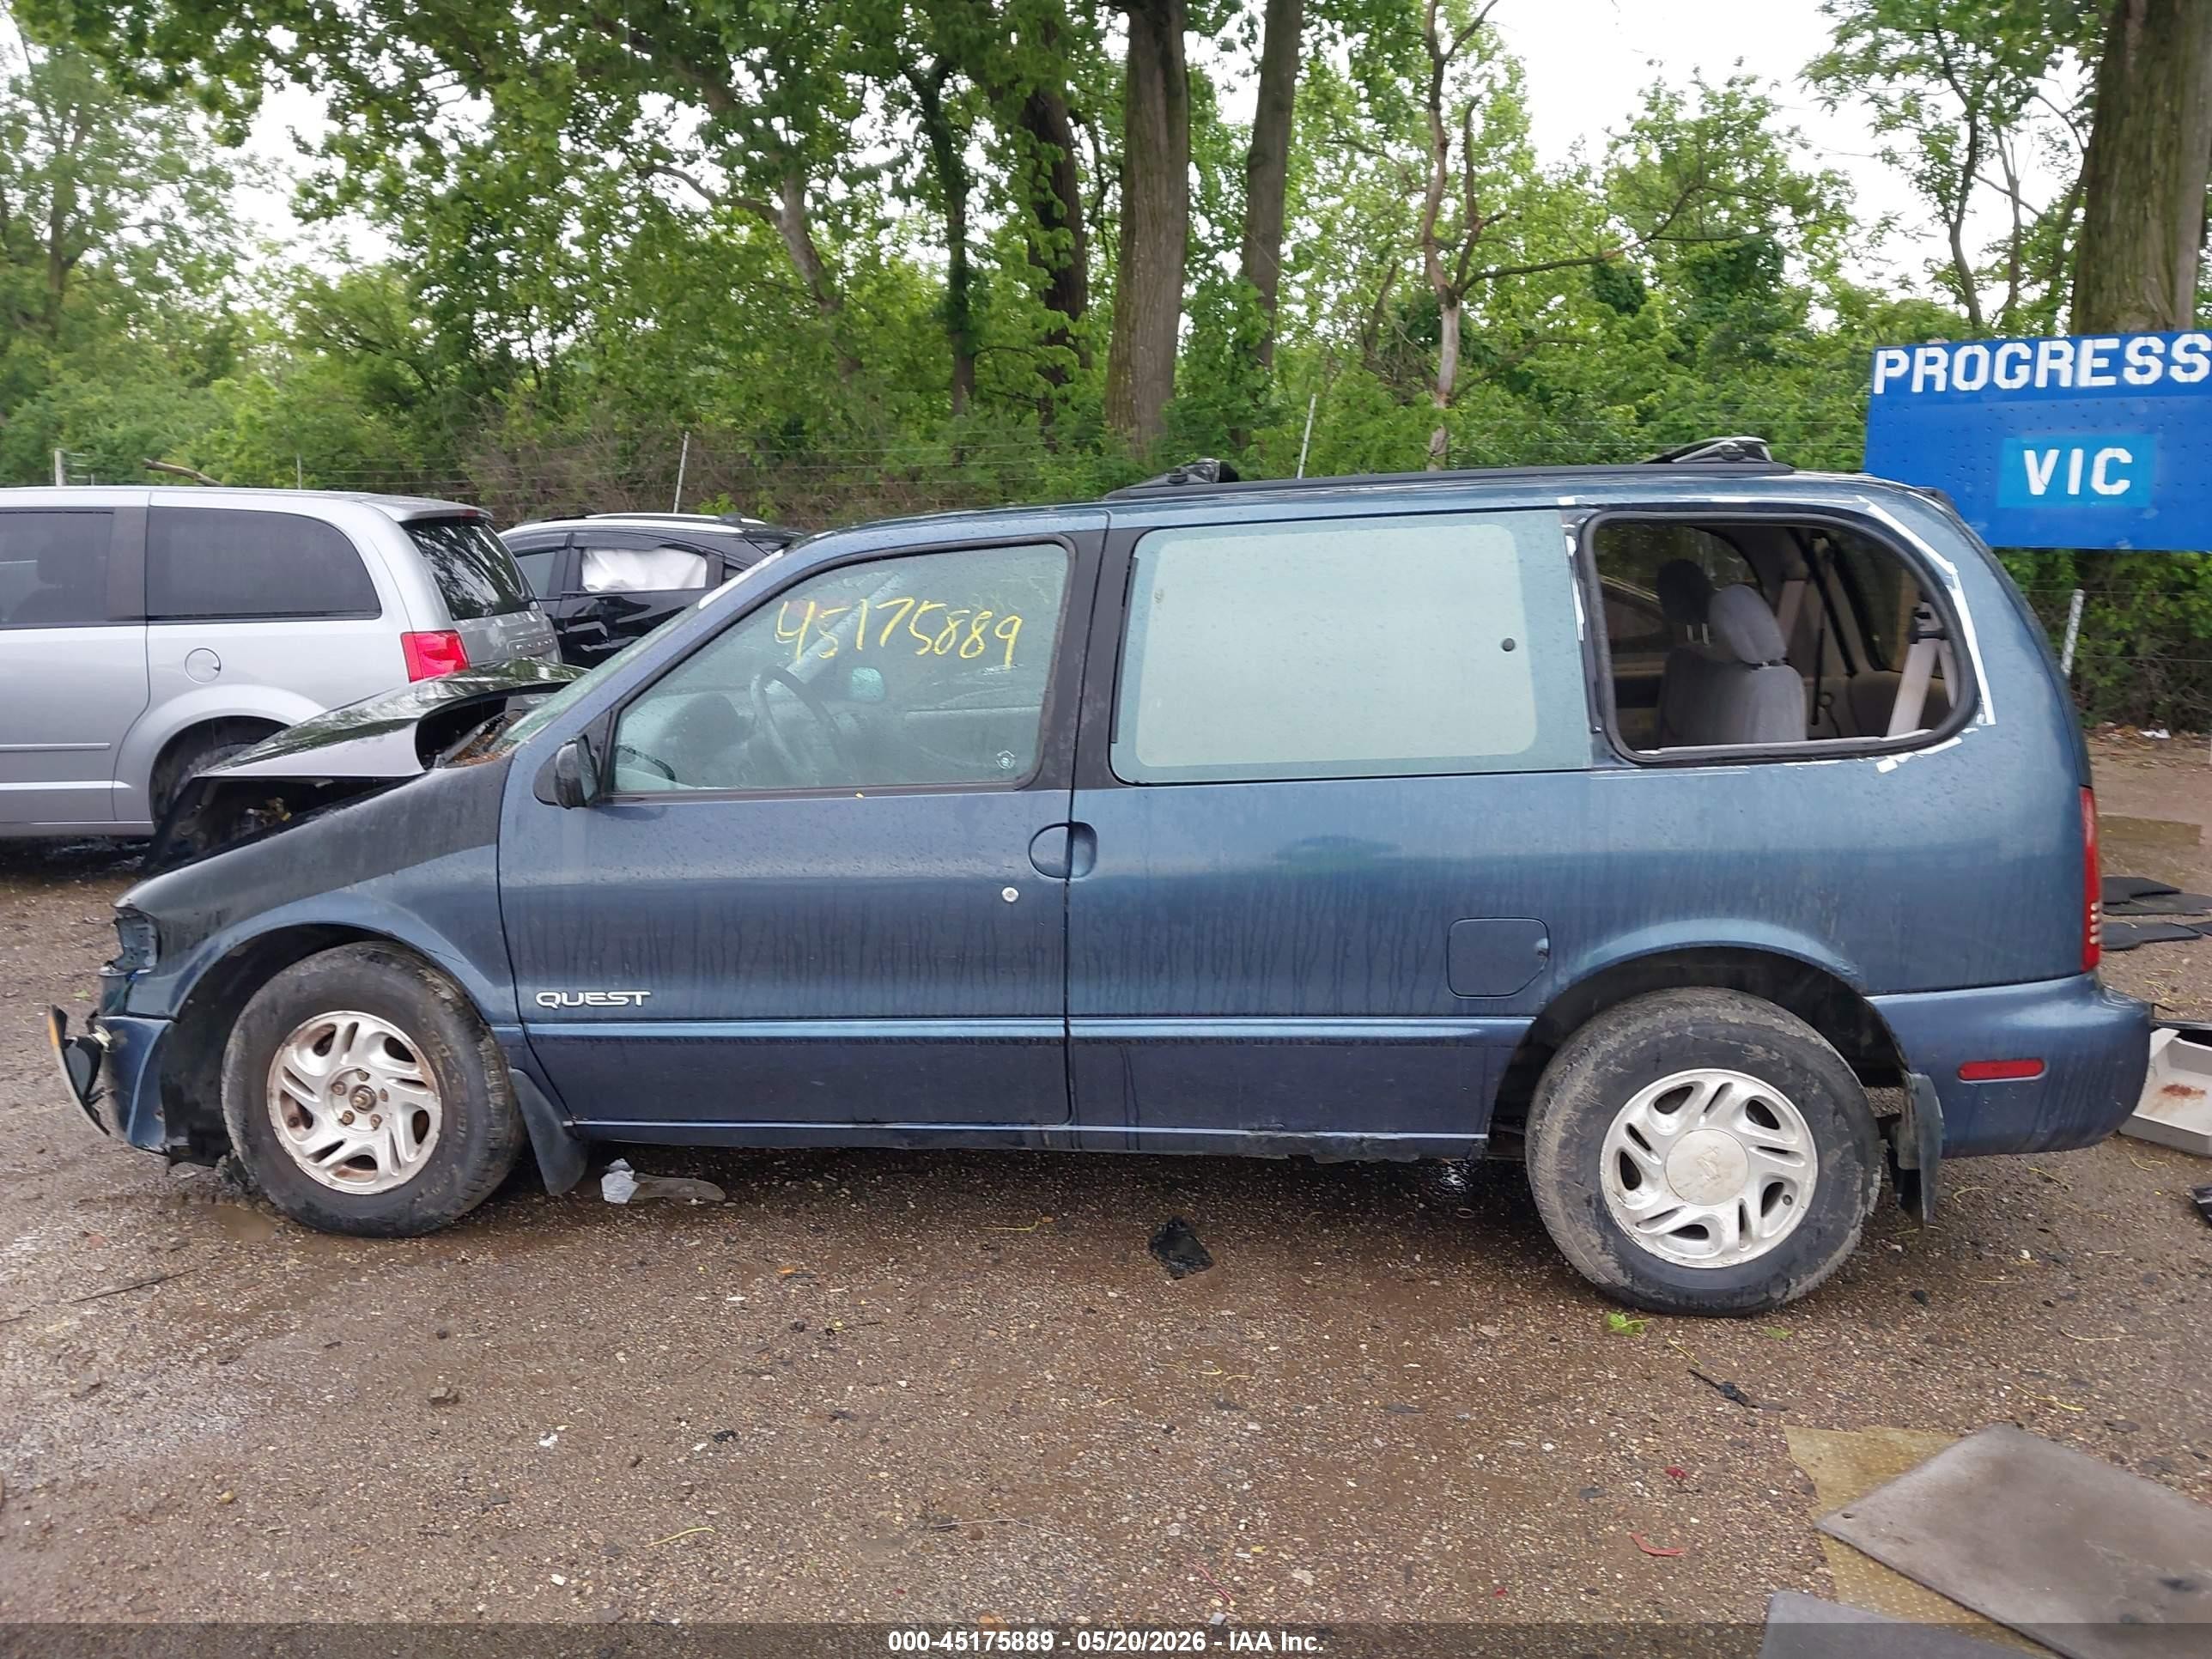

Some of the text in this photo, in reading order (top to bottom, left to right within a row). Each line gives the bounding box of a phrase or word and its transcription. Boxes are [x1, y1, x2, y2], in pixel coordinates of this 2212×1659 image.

[1874, 333, 2212, 394] PROGRESS
[2024, 447, 2133, 496] VIC
[774, 597, 1022, 669] 45175889
[535, 991, 651, 1009] QUEST
